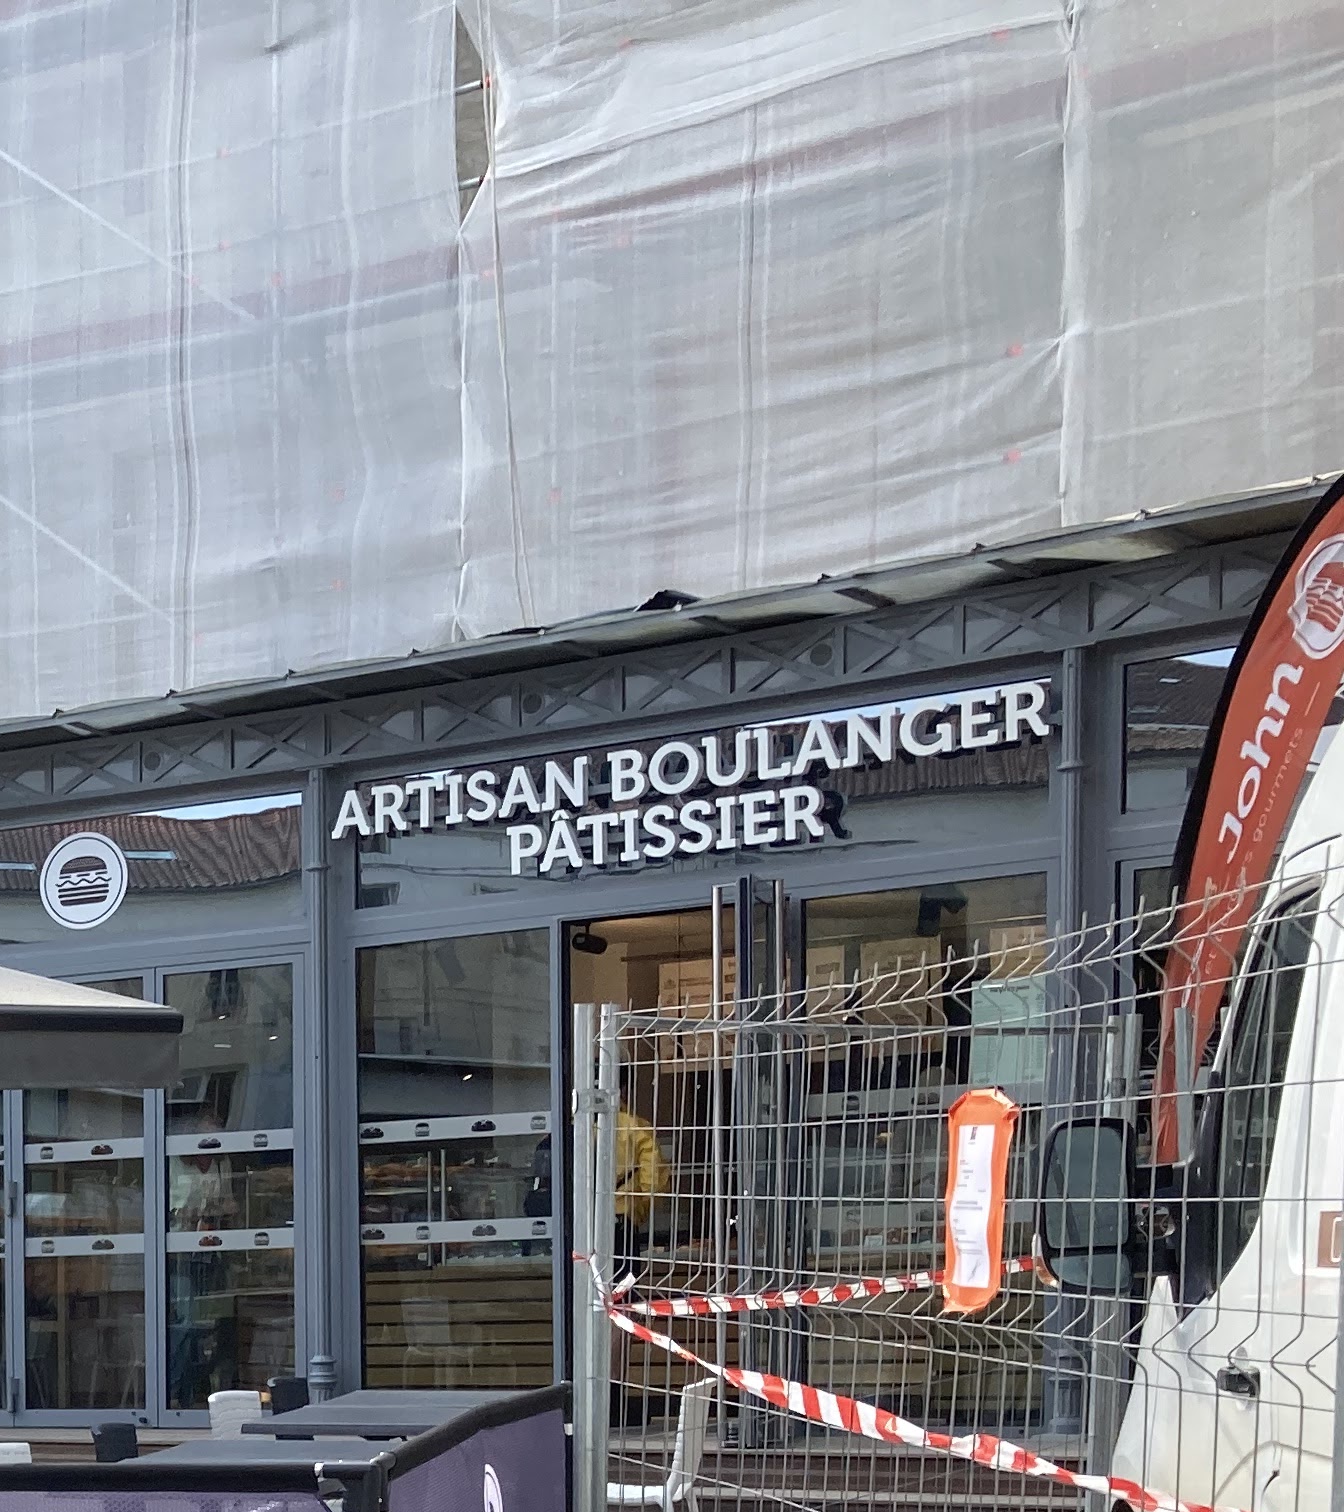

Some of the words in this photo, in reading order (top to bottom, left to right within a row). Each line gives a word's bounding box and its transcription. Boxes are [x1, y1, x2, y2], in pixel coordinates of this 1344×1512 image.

[331, 755, 588, 840] ARTISAN
[606, 680, 1053, 801] BOULANGER
[506, 785, 825, 876] PÂTISSIER
[1218, 662, 1305, 865] John
